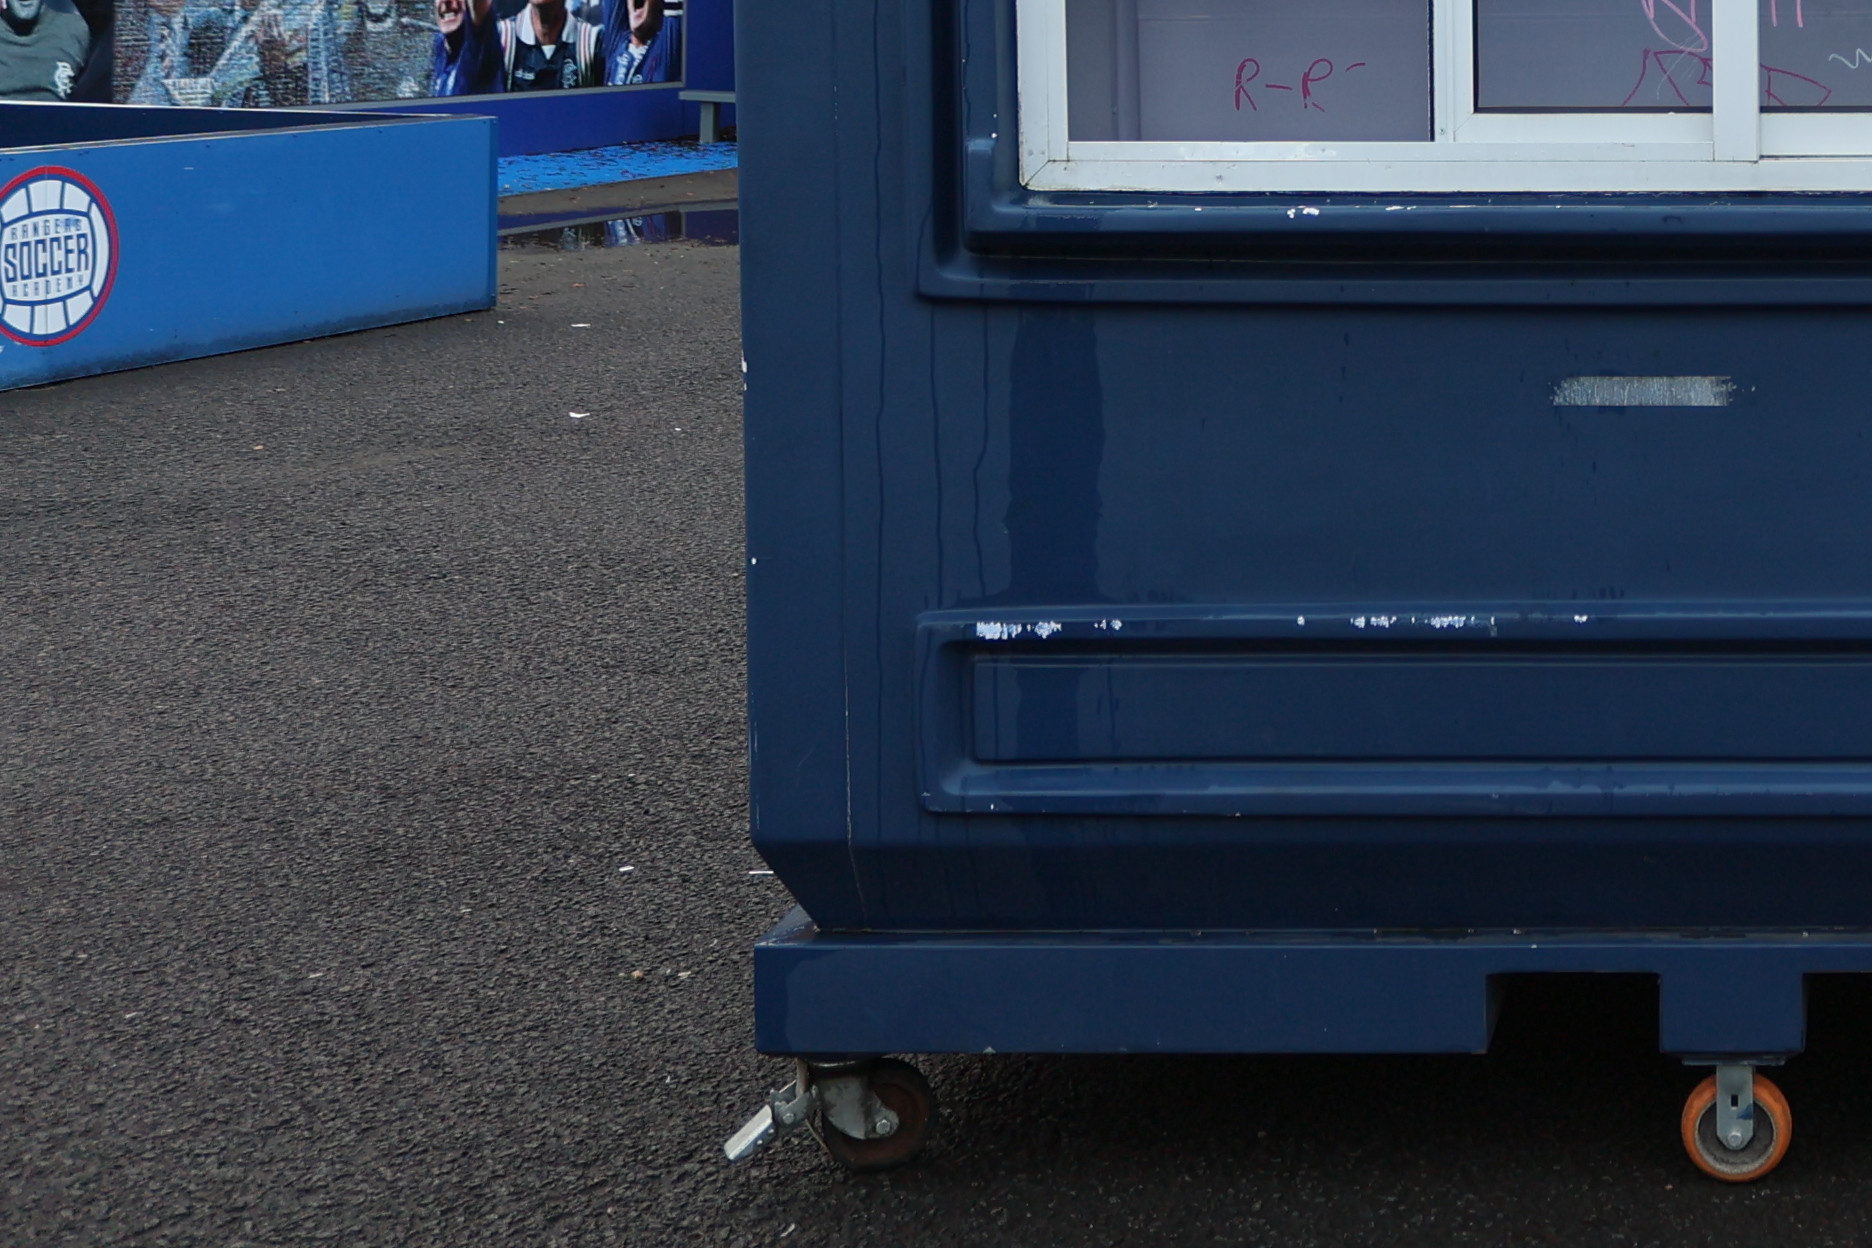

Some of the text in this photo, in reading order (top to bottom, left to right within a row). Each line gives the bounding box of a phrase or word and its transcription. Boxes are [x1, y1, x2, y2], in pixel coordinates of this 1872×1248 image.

[11, 218, 82, 240] RANGERS
[4, 233, 90, 283] SOCCER
[12, 274, 84, 297] ACADEMY
